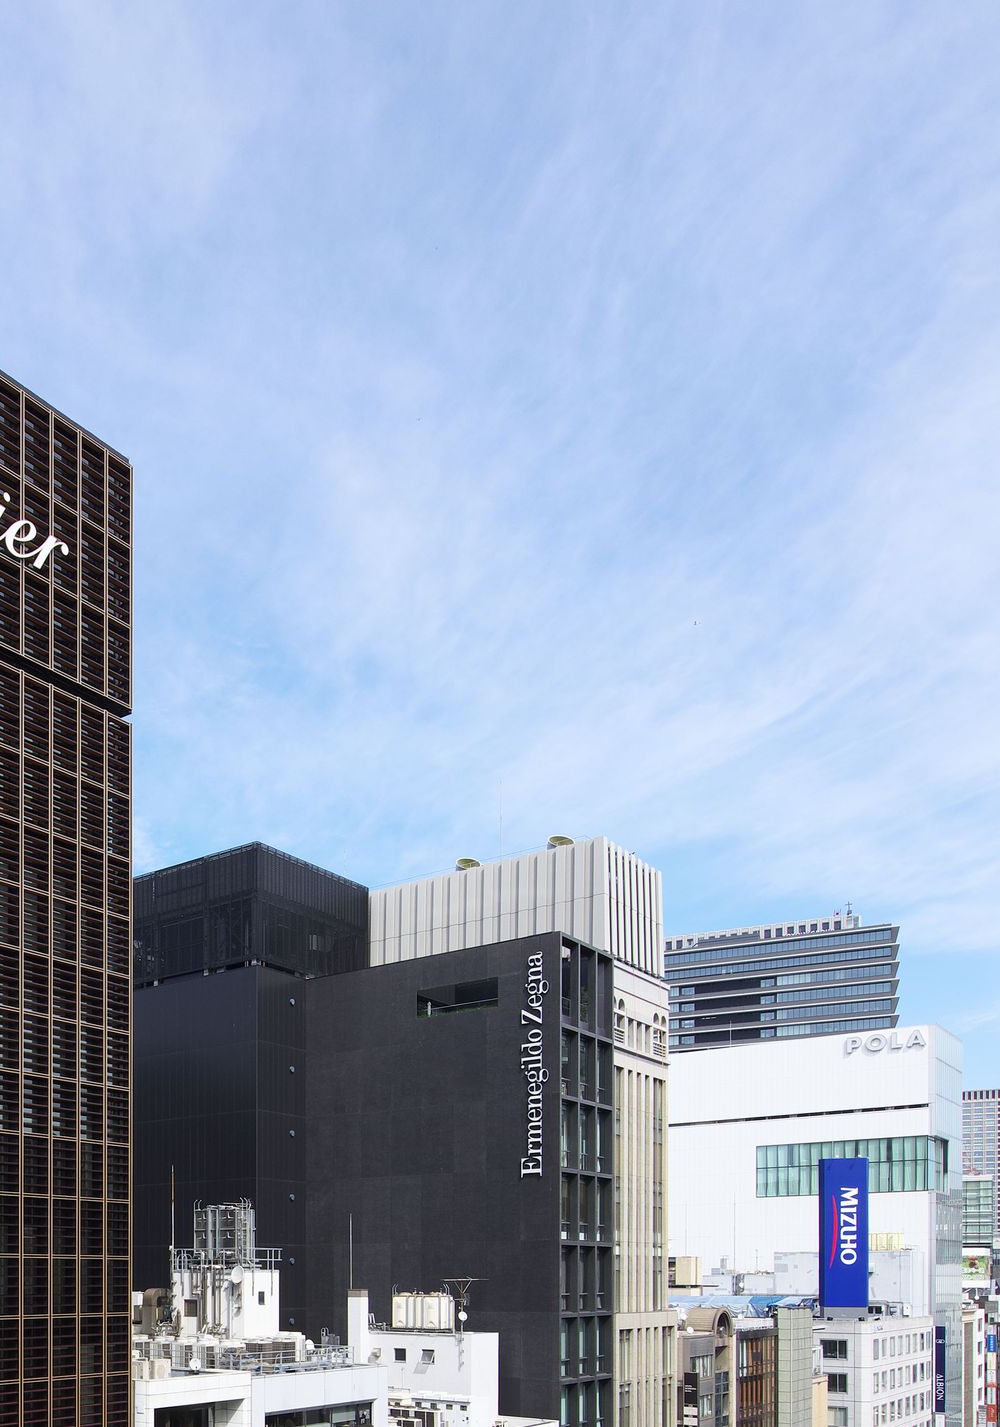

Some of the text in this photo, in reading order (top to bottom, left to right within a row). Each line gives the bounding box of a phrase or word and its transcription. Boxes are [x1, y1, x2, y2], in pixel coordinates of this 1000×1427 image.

[521, 951, 549, 1178] Ermenegildo Zegna
[845, 1029, 927, 1056] POLA
[840, 1186, 859, 1266] MIZUHO
[936, 1373, 945, 1401] ALBION
